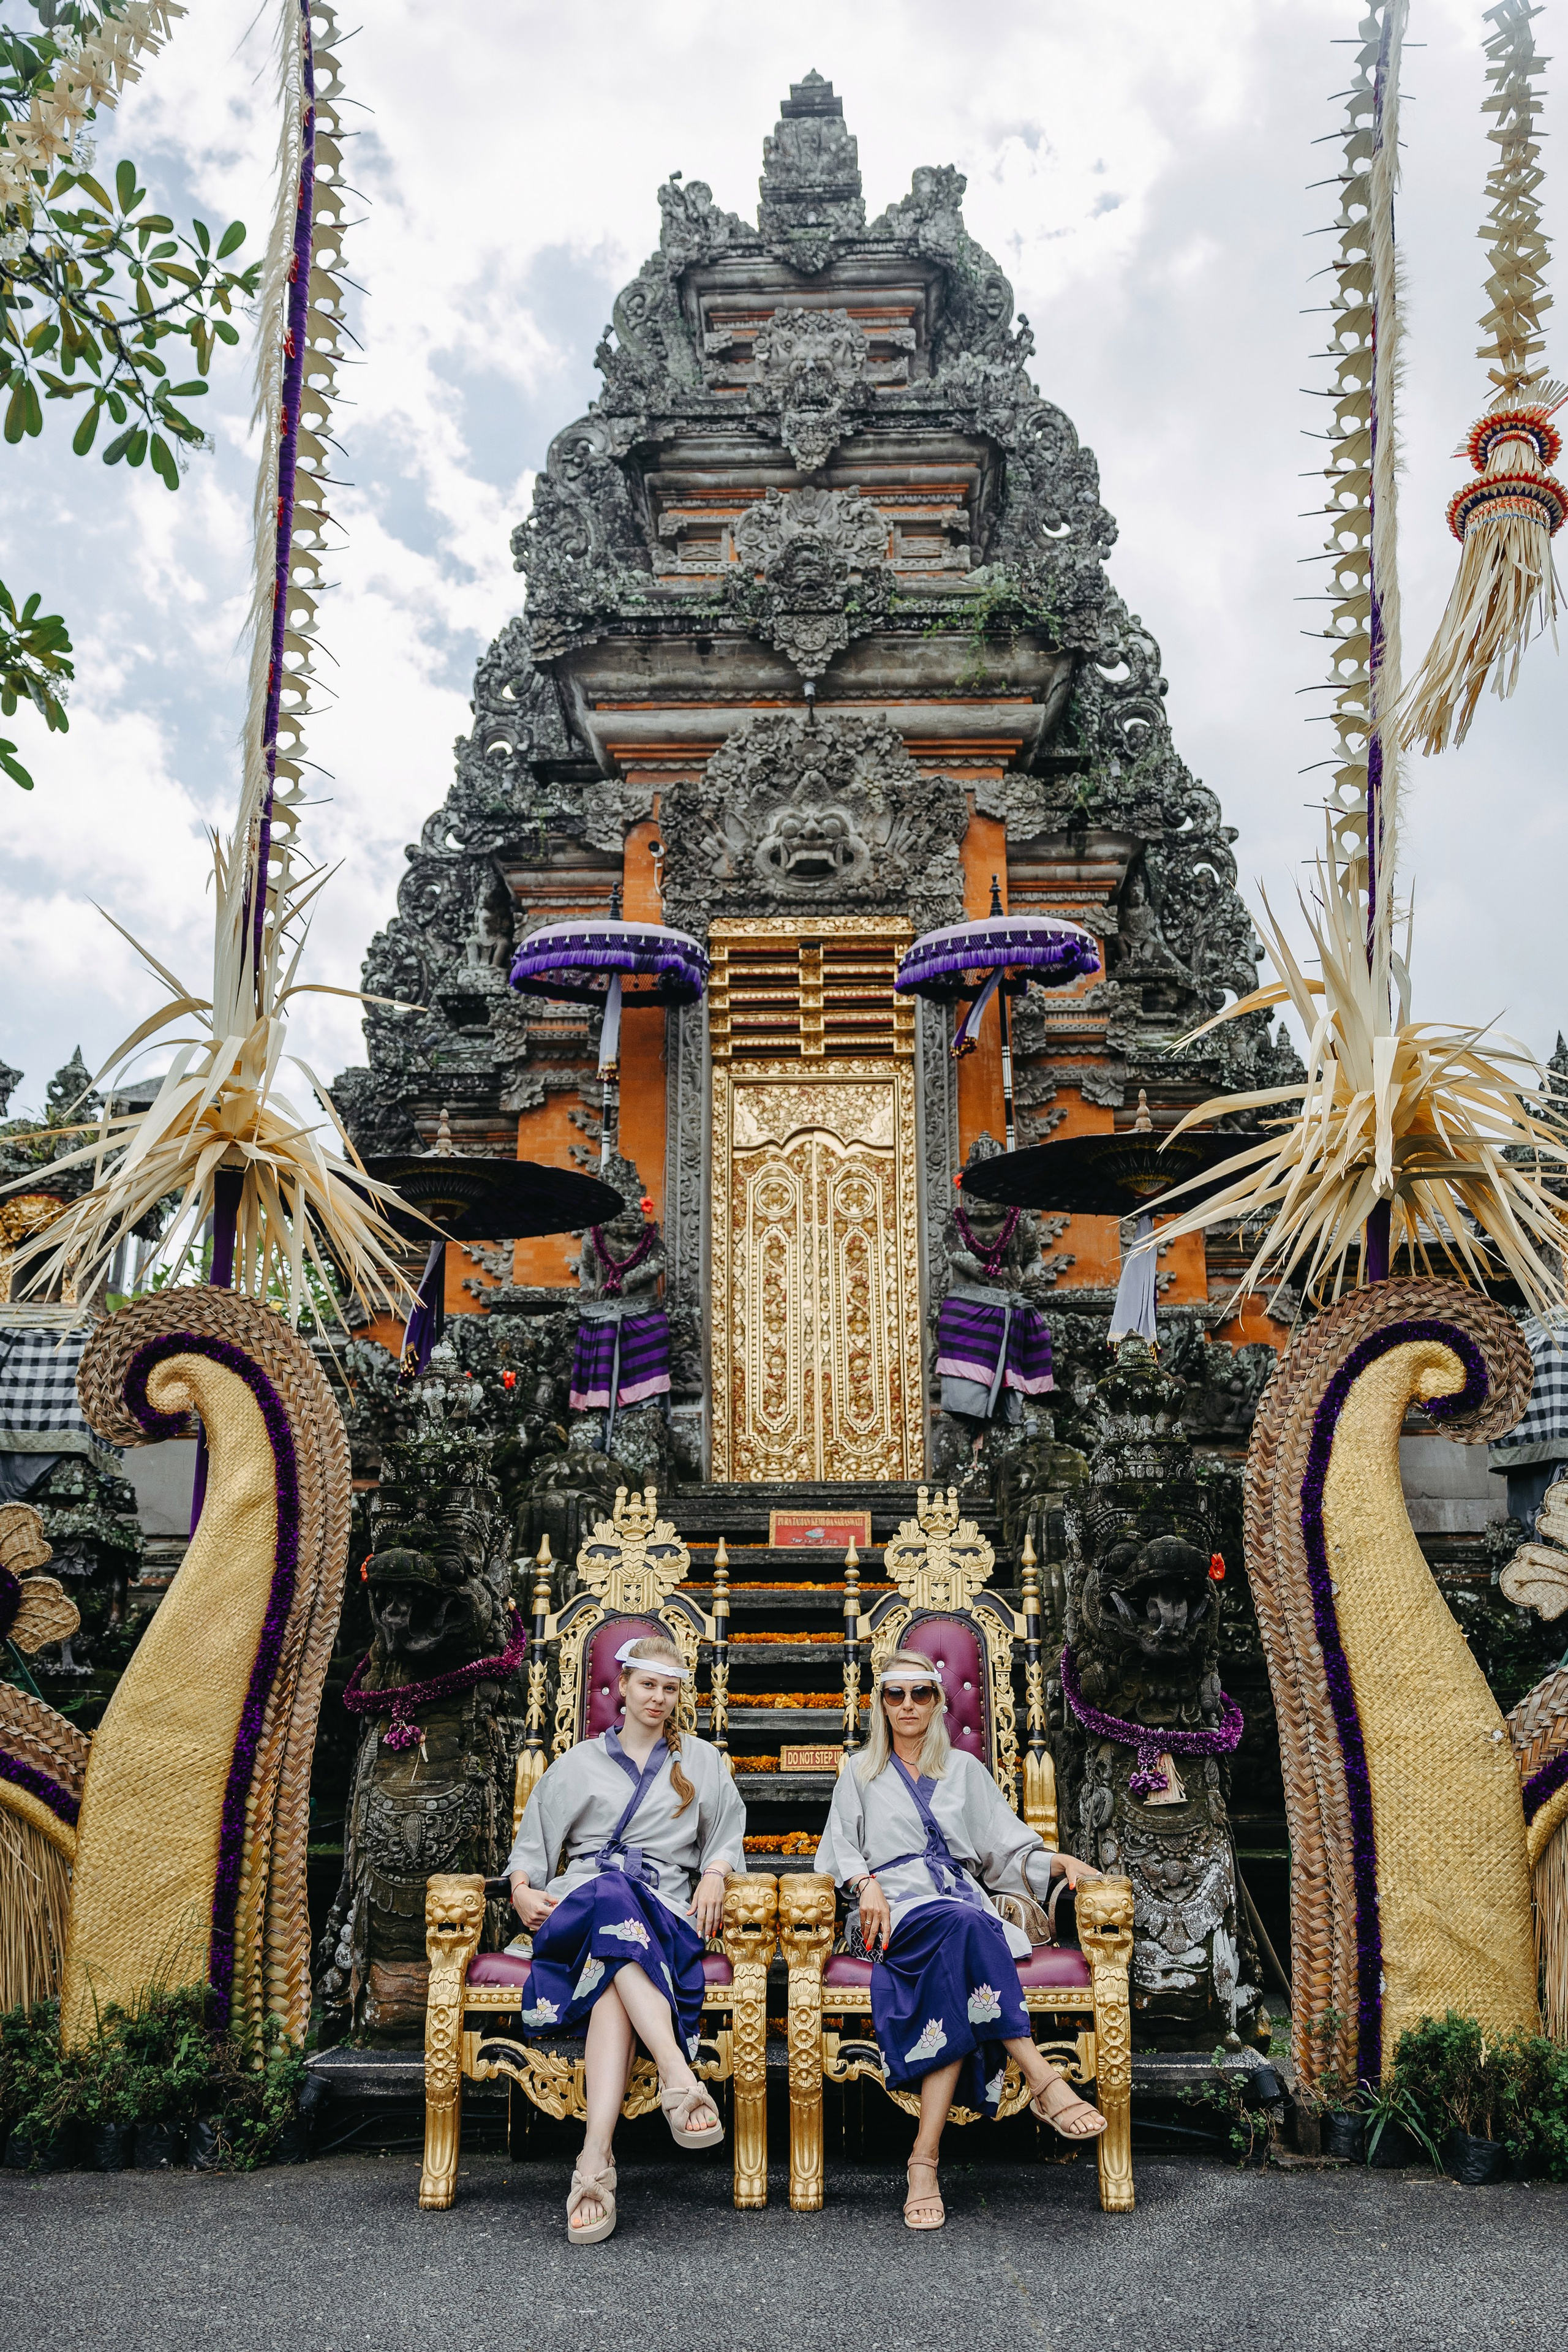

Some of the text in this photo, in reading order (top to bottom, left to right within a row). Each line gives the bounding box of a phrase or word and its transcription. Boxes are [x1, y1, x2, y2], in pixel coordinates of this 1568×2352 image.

[778, 1517, 792, 1526] PURA
[788, 1752, 798, 1765] DO
[799, 1752, 814, 1765] NOT
[815, 1751, 833, 1765] STEP
